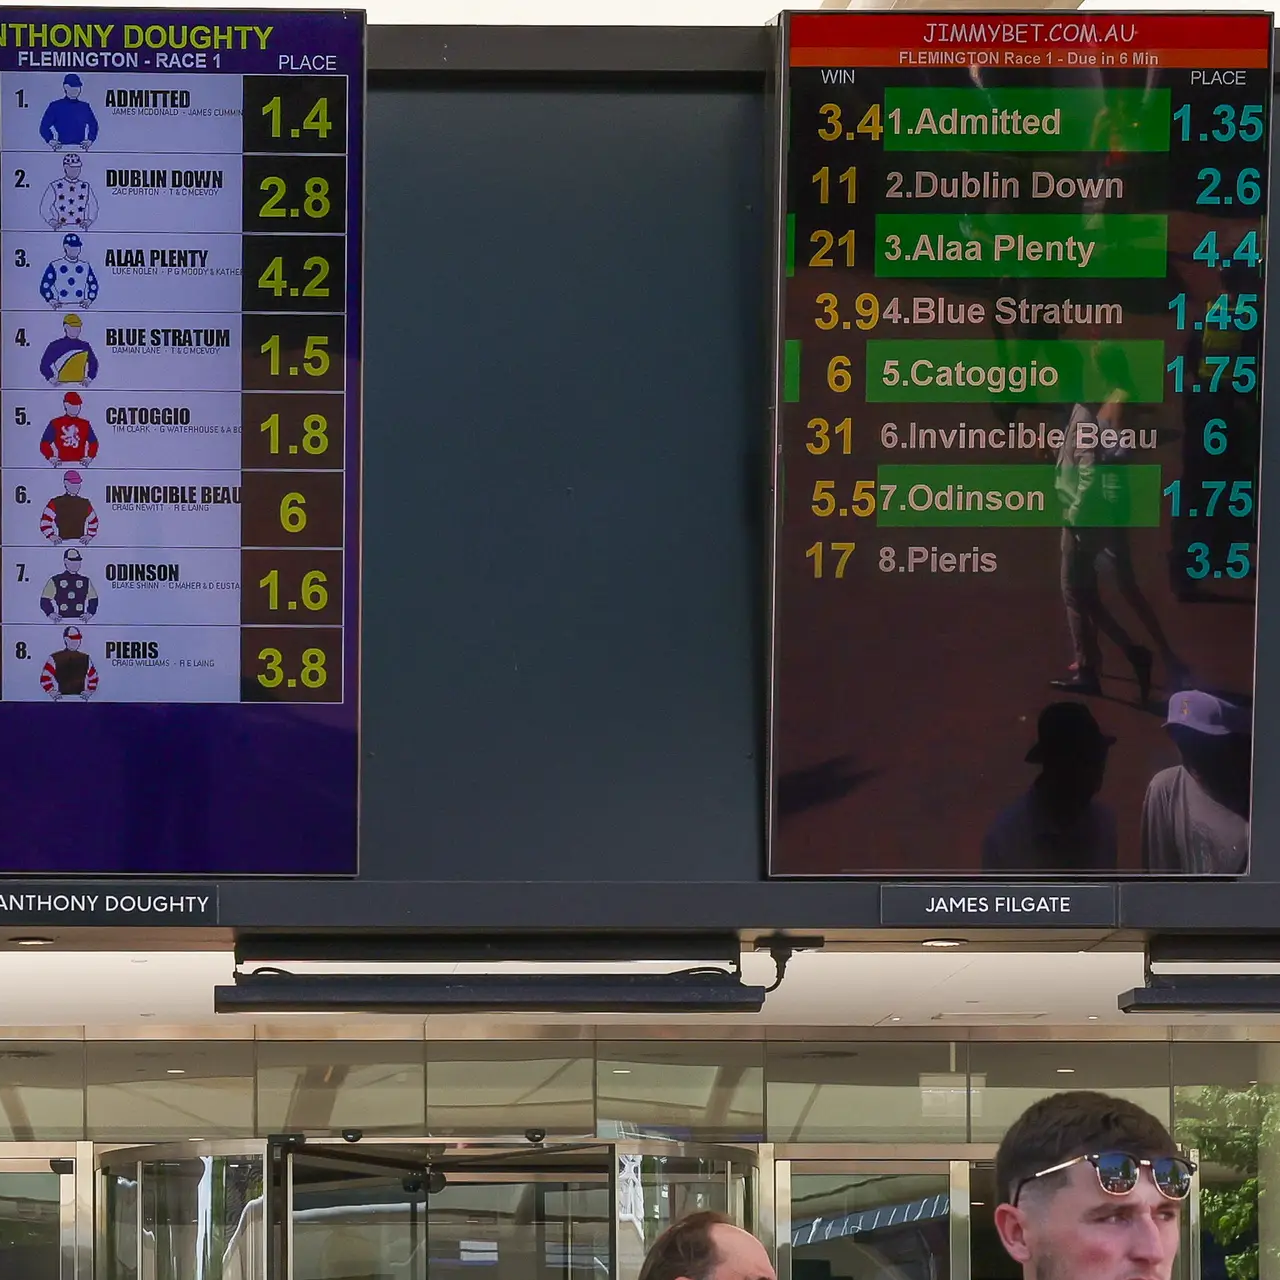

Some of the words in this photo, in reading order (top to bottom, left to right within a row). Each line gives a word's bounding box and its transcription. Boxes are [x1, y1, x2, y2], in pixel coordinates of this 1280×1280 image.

[124, 25, 274, 50] DOUGHTY
[924, 24, 1136, 44] JIMMYBET.COM.AU
[18, 52, 135, 68] FLEMINGTON
[157, 53, 205, 68] RACE
[213, 54, 221, 68] 1
[278, 55, 337, 71] PLACE
[899, 51, 1000, 65] FLEMINGTON
[1004, 51, 1041, 65] Race
[1046, 51, 1053, 65] 1
[1068, 51, 1097, 65] Due
[1102, 51, 1115, 65] in
[1120, 51, 1128, 65] 6
[1132, 51, 1158, 65] Min
[821, 69, 855, 84] WIN
[1191, 70, 1245, 86] PLACE
[106, 90, 190, 108] ADMITTED
[261, 97, 332, 138] 1.4
[818, 103, 883, 141] 3.4
[1173, 104, 1263, 142] 1.35
[106, 170, 166, 187] DUBLIN
[172, 171, 222, 188] DOWN
[1032, 172, 1123, 199] Down
[106, 250, 145, 266] ALAA
[150, 250, 208, 267] PLENTY
[995, 235, 1096, 267] Plenty
[996, 297, 1123, 325] Stratum
[106, 329, 145, 346] BLUE
[151, 330, 230, 346] STRATUM
[1167, 356, 1256, 393] 1.75
[106, 408, 190, 425] CATOGGIO
[1078, 422, 1158, 450] Beau
[106, 486, 196, 503] INVINCIBLE
[202, 487, 241, 504] BEAU
[106, 564, 179, 581] ODINSON
[106, 642, 158, 658] PIERIS
[257, 648, 327, 688] 3.8
[105, 896, 209, 913] DOUGHTY
[926, 897, 989, 913] JAMES
[996, 897, 1071, 912] FILGATE
